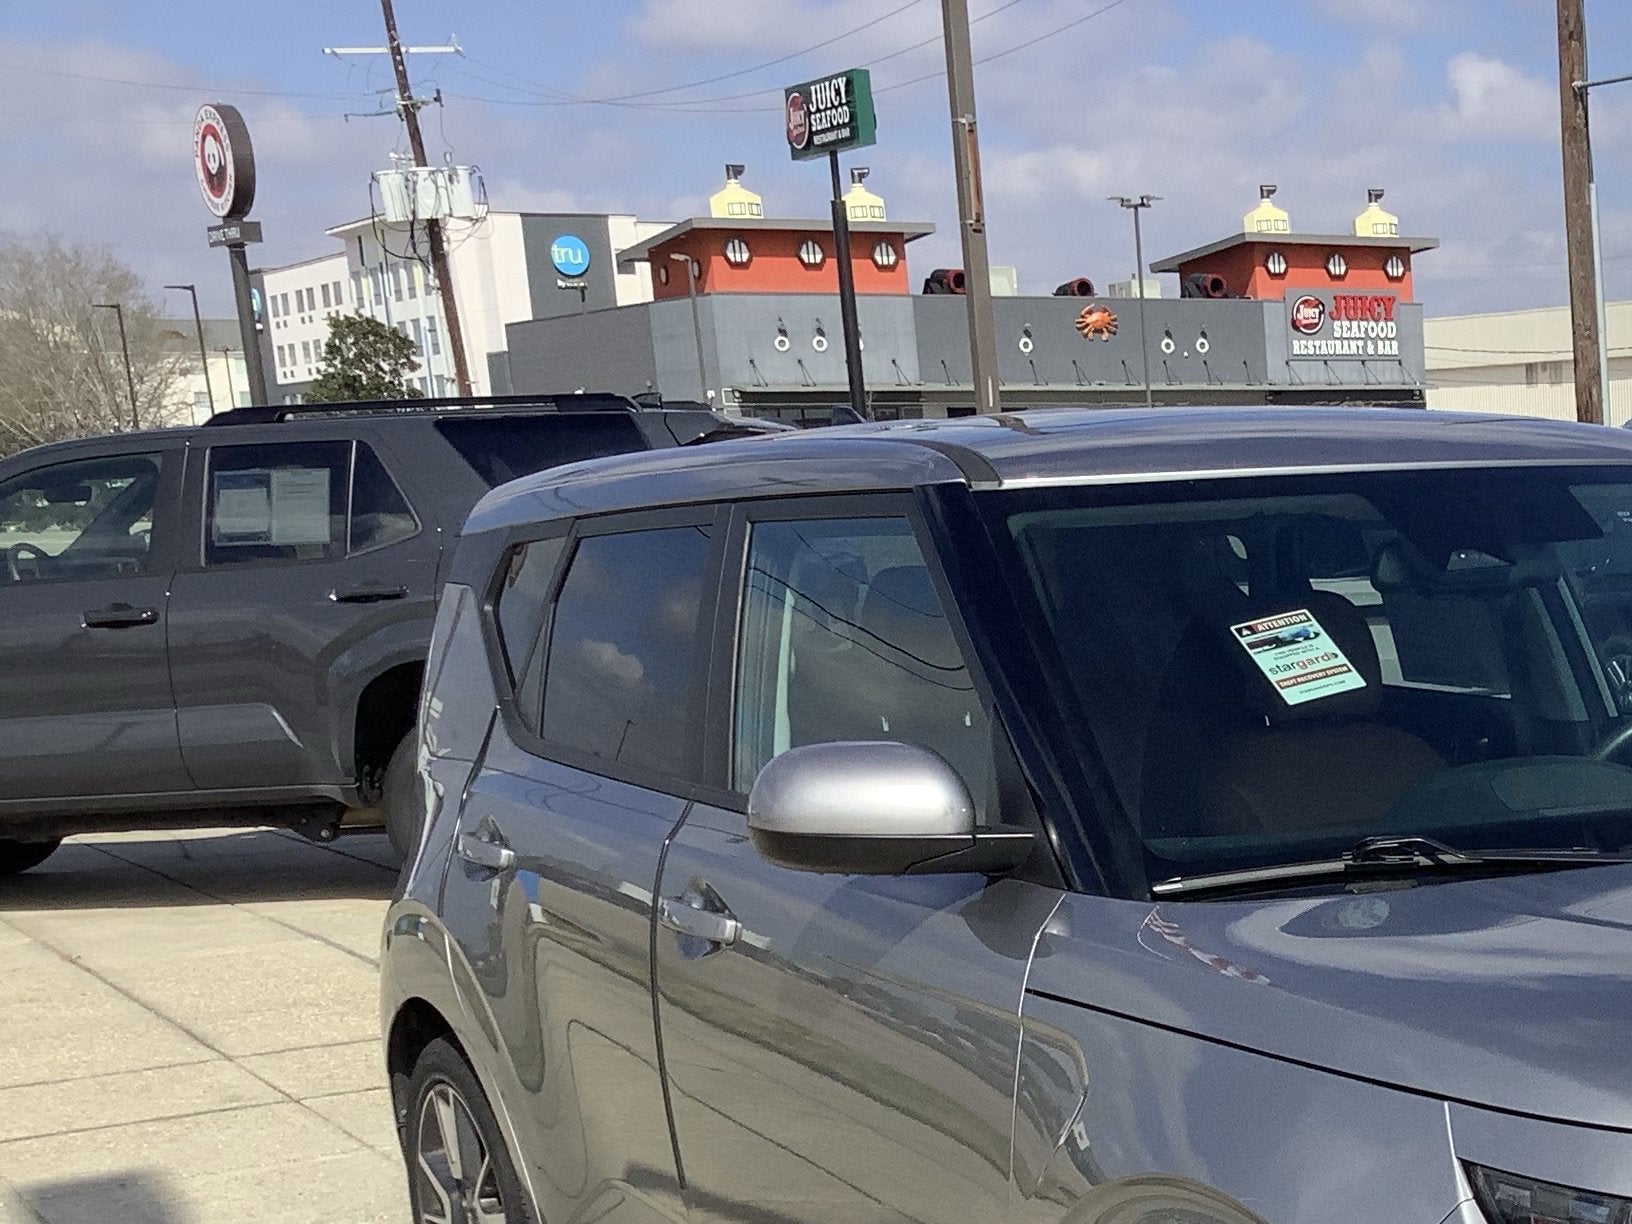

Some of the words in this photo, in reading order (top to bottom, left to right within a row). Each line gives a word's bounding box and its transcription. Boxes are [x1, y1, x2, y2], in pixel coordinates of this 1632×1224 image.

[809, 76, 847, 113] JUICY
[810, 105, 850, 132] SEAFOOD
[551, 243, 583, 265] tru
[1297, 304, 1321, 321] JUICY
[1329, 295, 1397, 321] JUICY
[1333, 321, 1397, 338] SEAFOOD
[1292, 340, 1365, 355] RESTAURANT
[1366, 340, 1375, 355] &
[1377, 340, 1399, 355] BAR
[1256, 613, 1308, 632] ATTENTION
[1268, 652, 1331, 675] stargard
